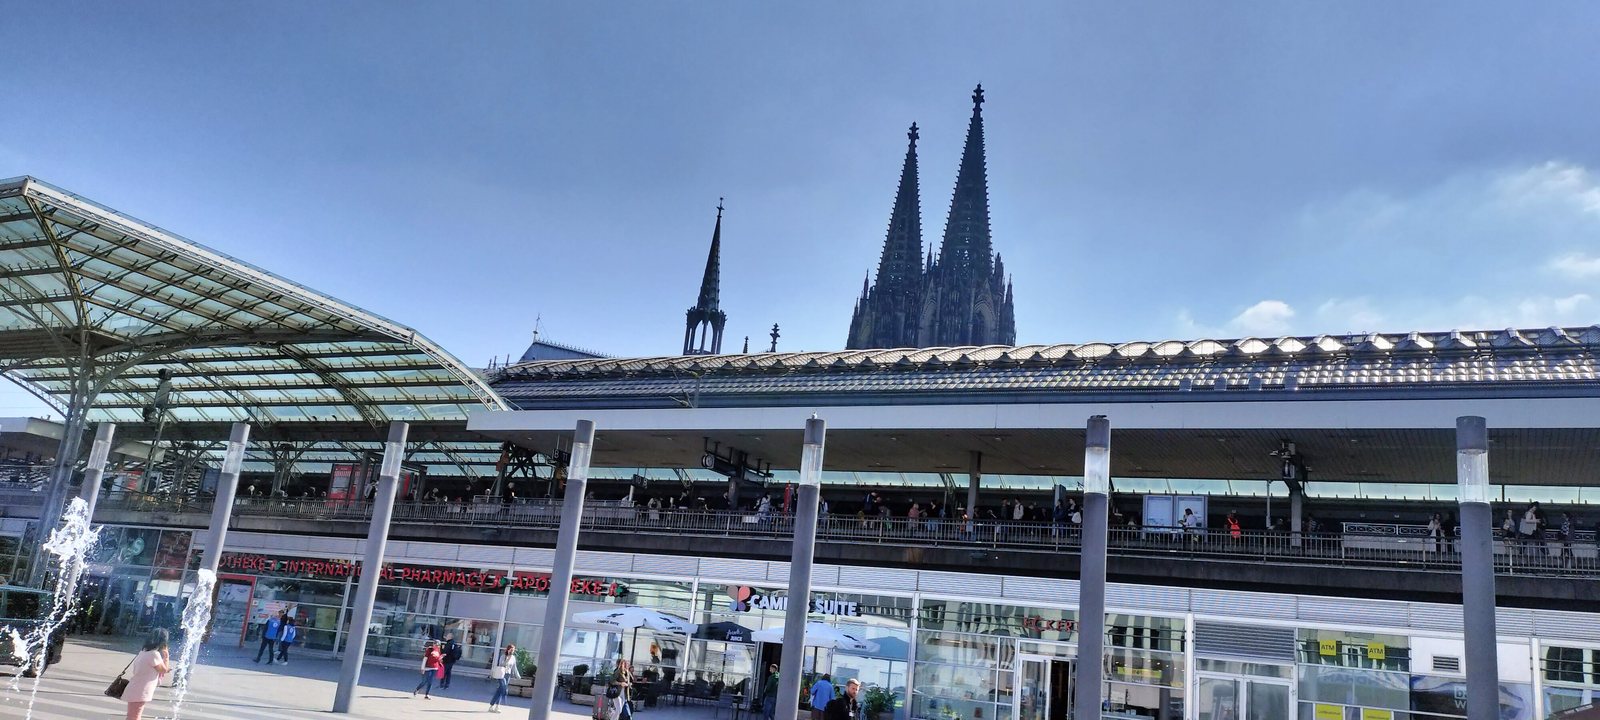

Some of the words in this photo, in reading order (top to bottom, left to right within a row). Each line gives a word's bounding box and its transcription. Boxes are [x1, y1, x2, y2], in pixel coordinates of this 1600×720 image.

[219, 555, 266, 571] OTHEKE
[402, 567, 489, 587] PHARMACY
[513, 575, 603, 596] APOEKE
[749, 594, 811, 612] CAM
[815, 599, 858, 616] SUITE
[1369, 647, 1384, 655] ATM
